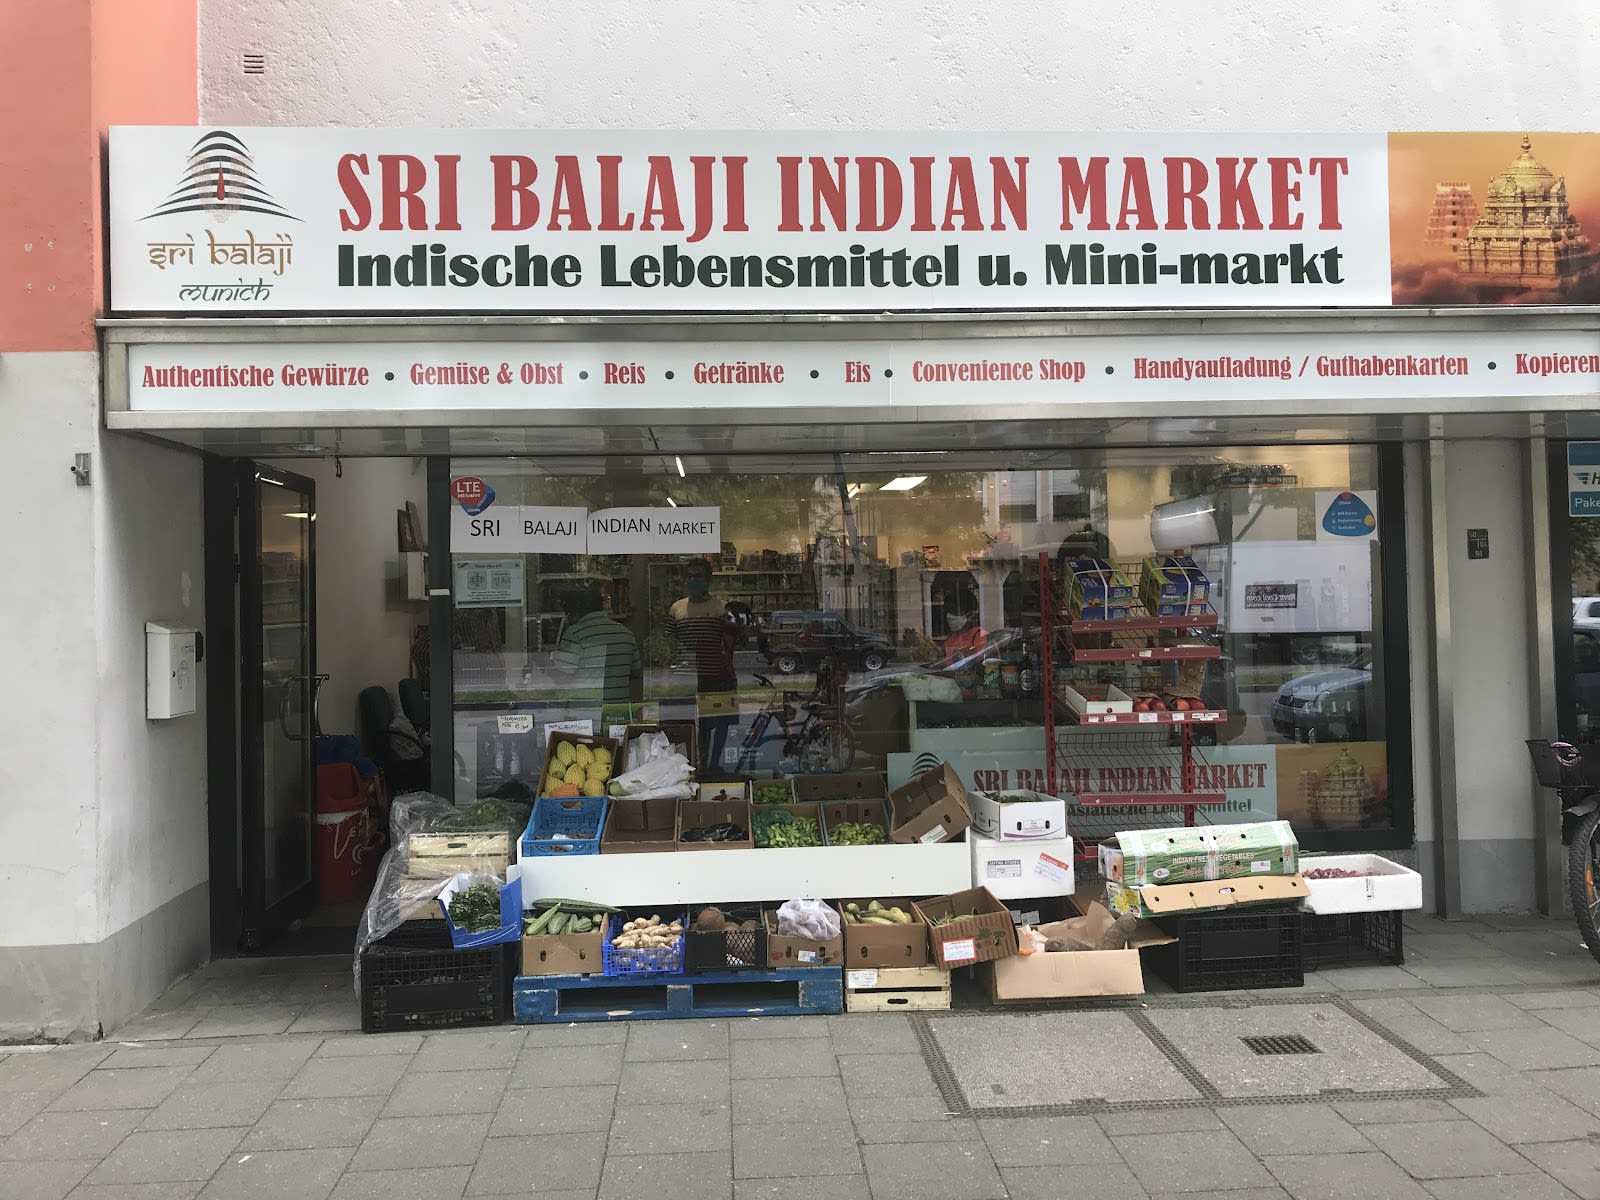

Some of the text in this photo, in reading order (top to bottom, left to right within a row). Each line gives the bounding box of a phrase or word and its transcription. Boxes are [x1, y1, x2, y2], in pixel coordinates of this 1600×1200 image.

[338, 154, 1349, 242] SRI BALAJI INDIAN MARKET
[147, 229, 293, 276] sri balaji
[338, 243, 1345, 288] Indische Lebensmittel u. Mini-markt
[178, 278, 274, 302] munich
[142, 352, 1600, 388] Authentische Gewürze Gemüse & Obst Reis Getränke Eis Convenience Shop Handyaufladung / Guthabenkarten Kopieren
[456, 481, 481, 493] LTE
[469, 517, 716, 538] SRI BALAJI INDIAN MARKET
[973, 769, 1009, 791] SRI
[1098, 766, 1172, 793] INDIAN
